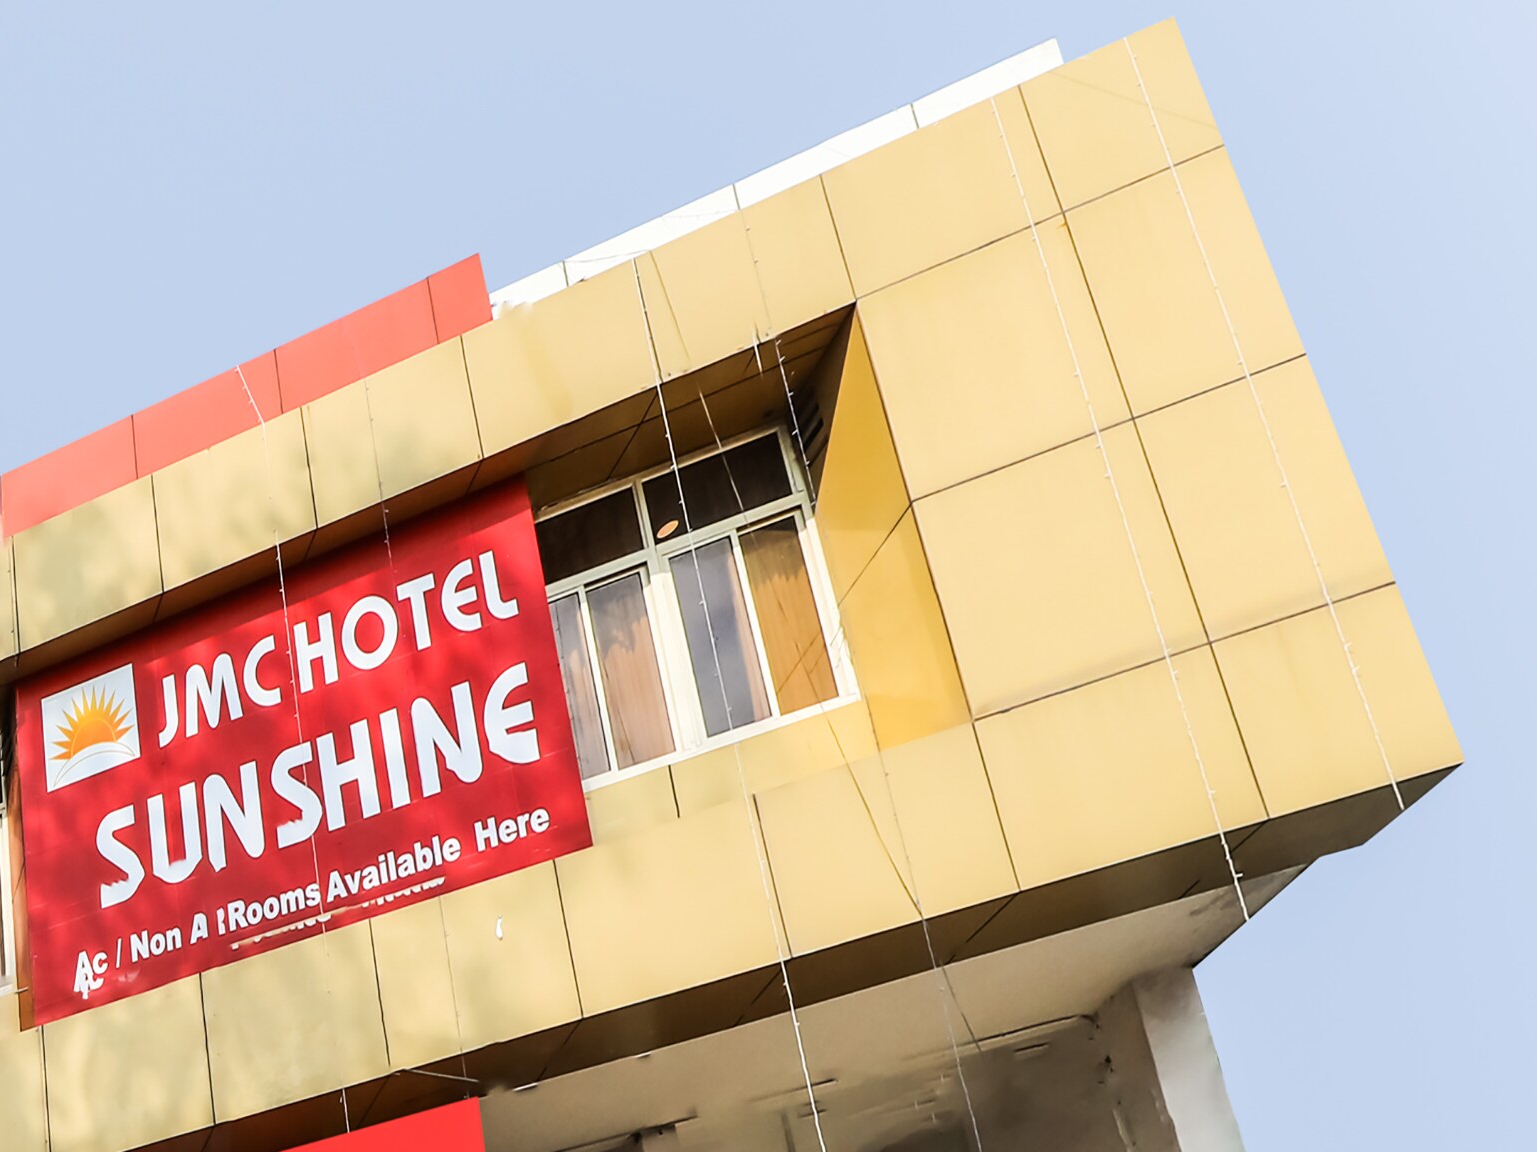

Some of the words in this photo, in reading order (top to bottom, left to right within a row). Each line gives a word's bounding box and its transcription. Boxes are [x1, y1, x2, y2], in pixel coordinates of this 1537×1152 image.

[158, 635, 281, 748] JMC
[293, 550, 519, 694] HOTEL
[95, 662, 541, 909] SUNSHINE
[130, 926, 182, 963] Non
[227, 882, 321, 931] Rooms
[326, 834, 461, 904] Available
[474, 806, 551, 852] Here
